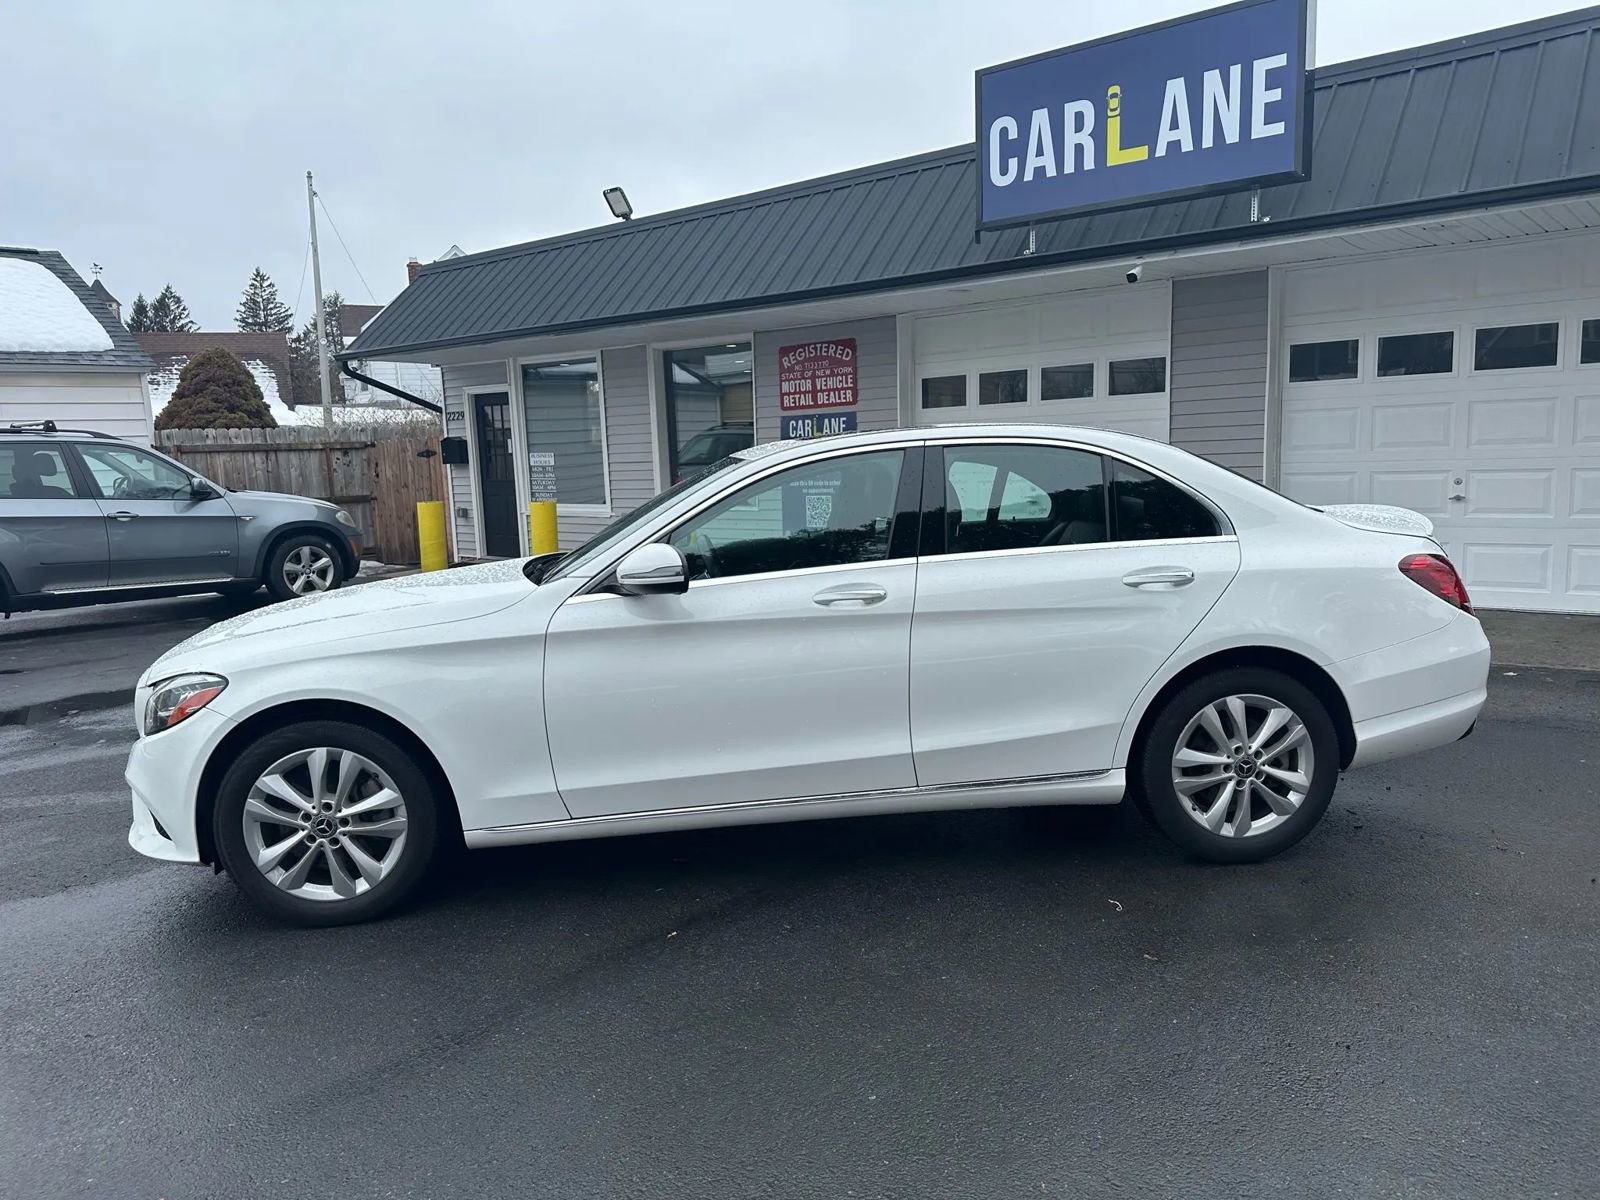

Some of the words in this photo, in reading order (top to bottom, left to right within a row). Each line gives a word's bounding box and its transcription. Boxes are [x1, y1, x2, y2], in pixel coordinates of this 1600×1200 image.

[990, 53, 1287, 187] CARLANE
[782, 344, 852, 368] REGISTERED
[781, 371, 801, 380] STATE
[834, 366, 853, 374] YORK
[782, 379, 812, 393] MOTOR
[816, 375, 853, 390] VEHICLE
[783, 392, 814, 407] RETAIL
[817, 390, 853, 405] DEALER
[447, 411, 464, 421] 2229
